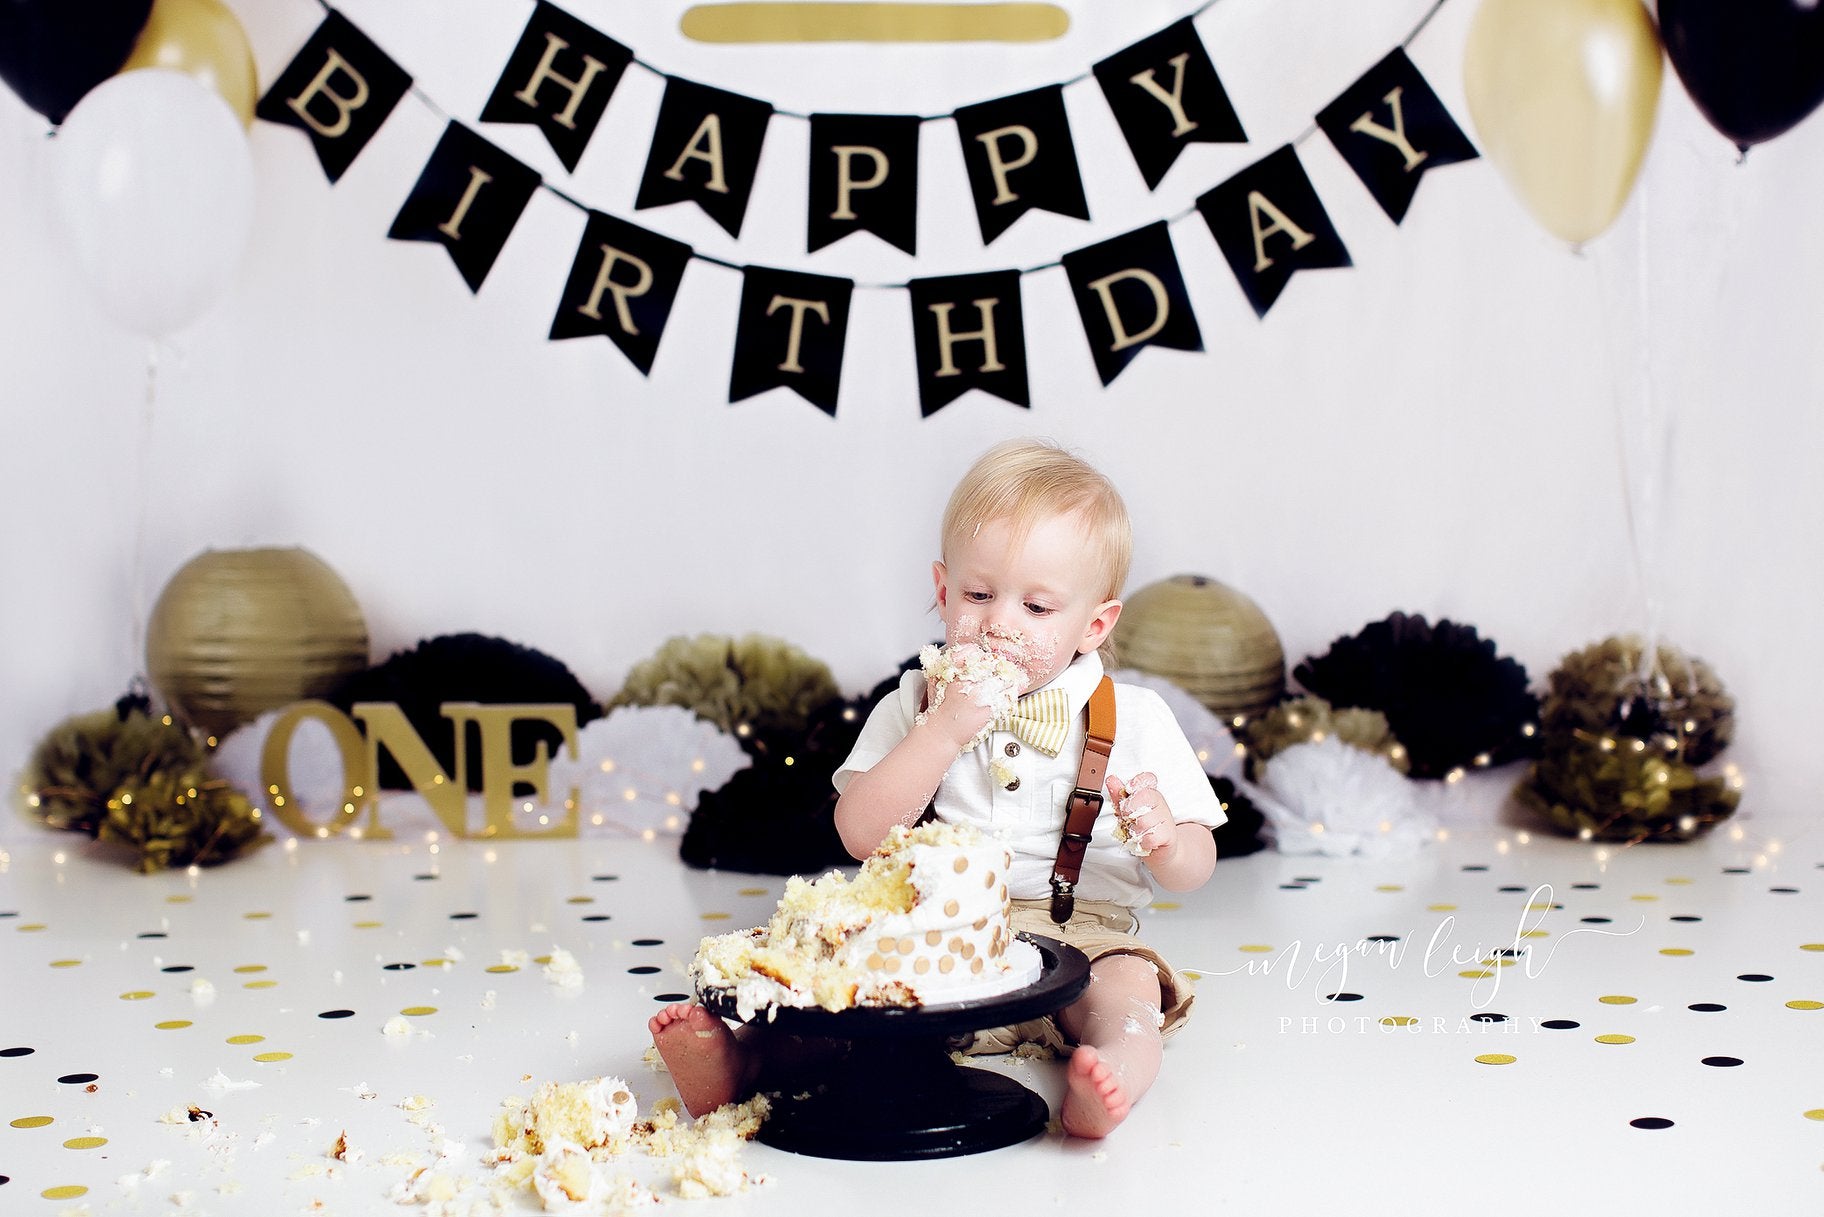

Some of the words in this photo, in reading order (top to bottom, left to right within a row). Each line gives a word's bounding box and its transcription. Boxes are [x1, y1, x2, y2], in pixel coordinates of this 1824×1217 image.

[287, 48, 1428, 376] BIRTHDAY
[514, 32, 1199, 220] HAPPY
[261, 699, 579, 839] ONE
